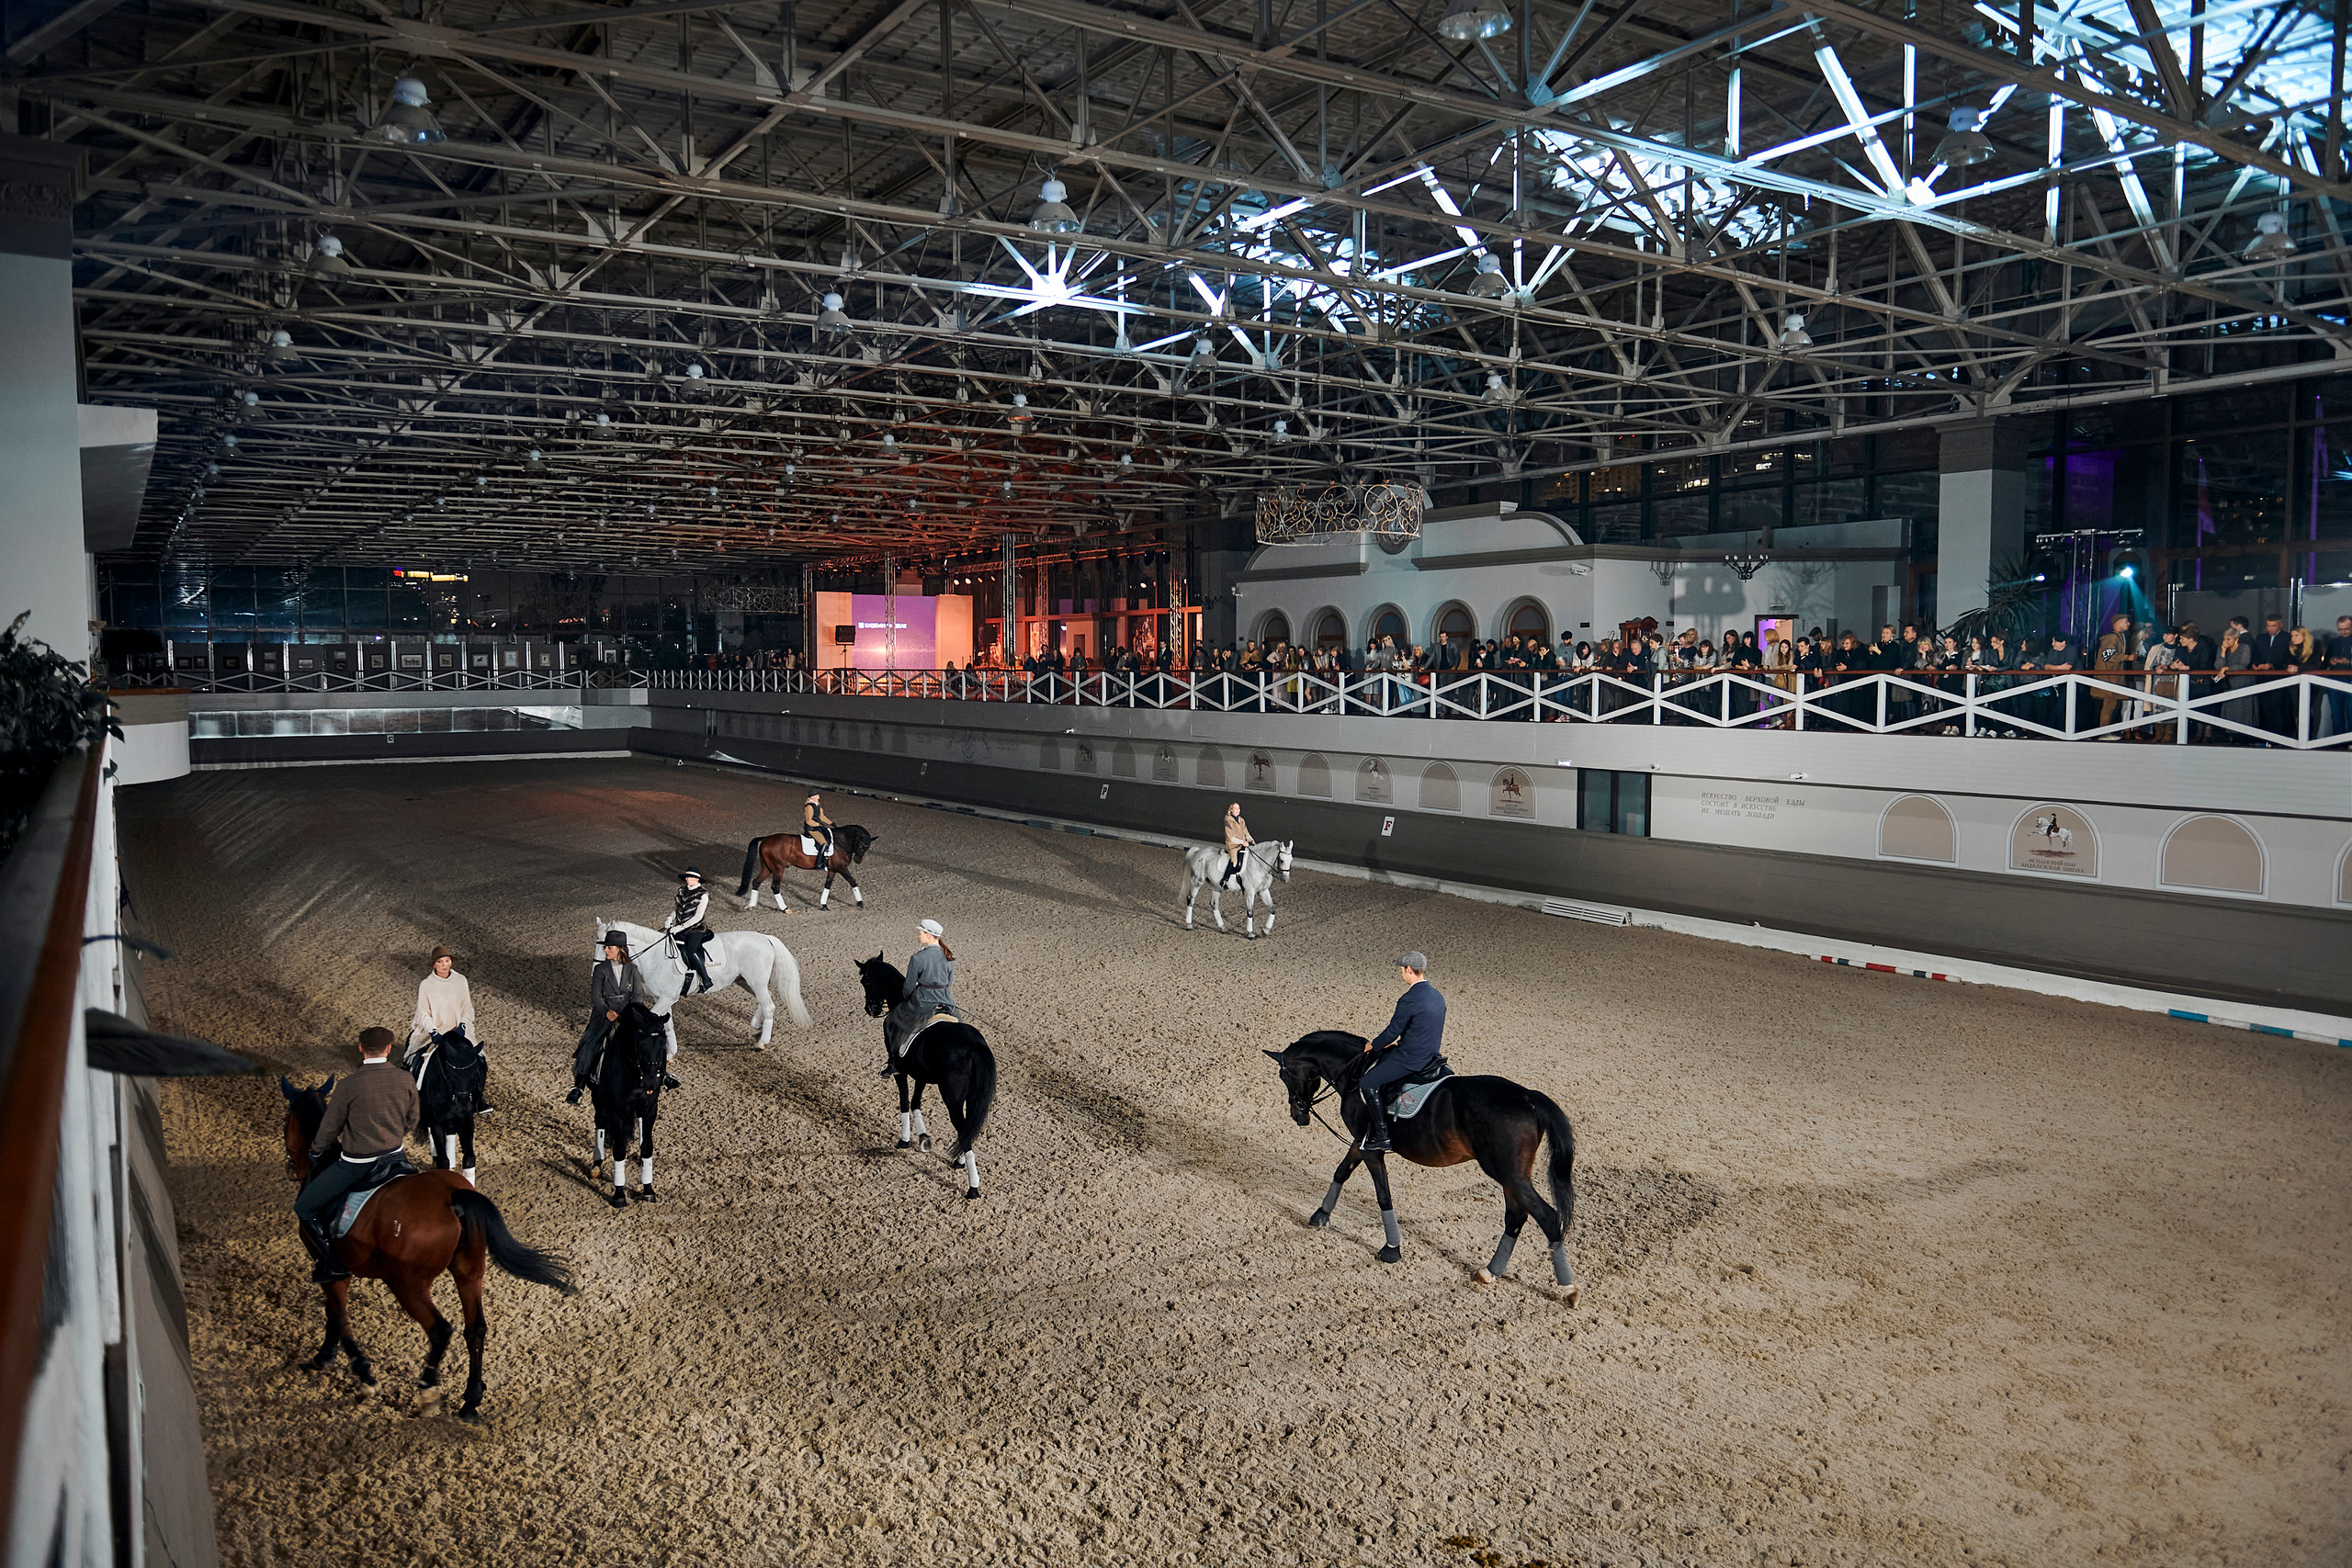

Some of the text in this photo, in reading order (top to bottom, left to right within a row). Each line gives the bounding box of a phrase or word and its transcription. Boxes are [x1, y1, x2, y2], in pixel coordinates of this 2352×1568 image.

[1701, 792, 1805, 807] ИСКУССТВО ВЕРХОВОЙ ЕЗДЫ
[1701, 799, 1729, 807] СОСТОИТ
[1741, 803, 1777, 812] ИСКУССТВЕ
[1714, 808, 1742, 817] МЕШАТЬ
[1745, 811, 1775, 819] ЛОШАДИ
[1384, 820, 1393, 830] F
[2028, 858, 2064, 866] ИСПАНСКИЙ
